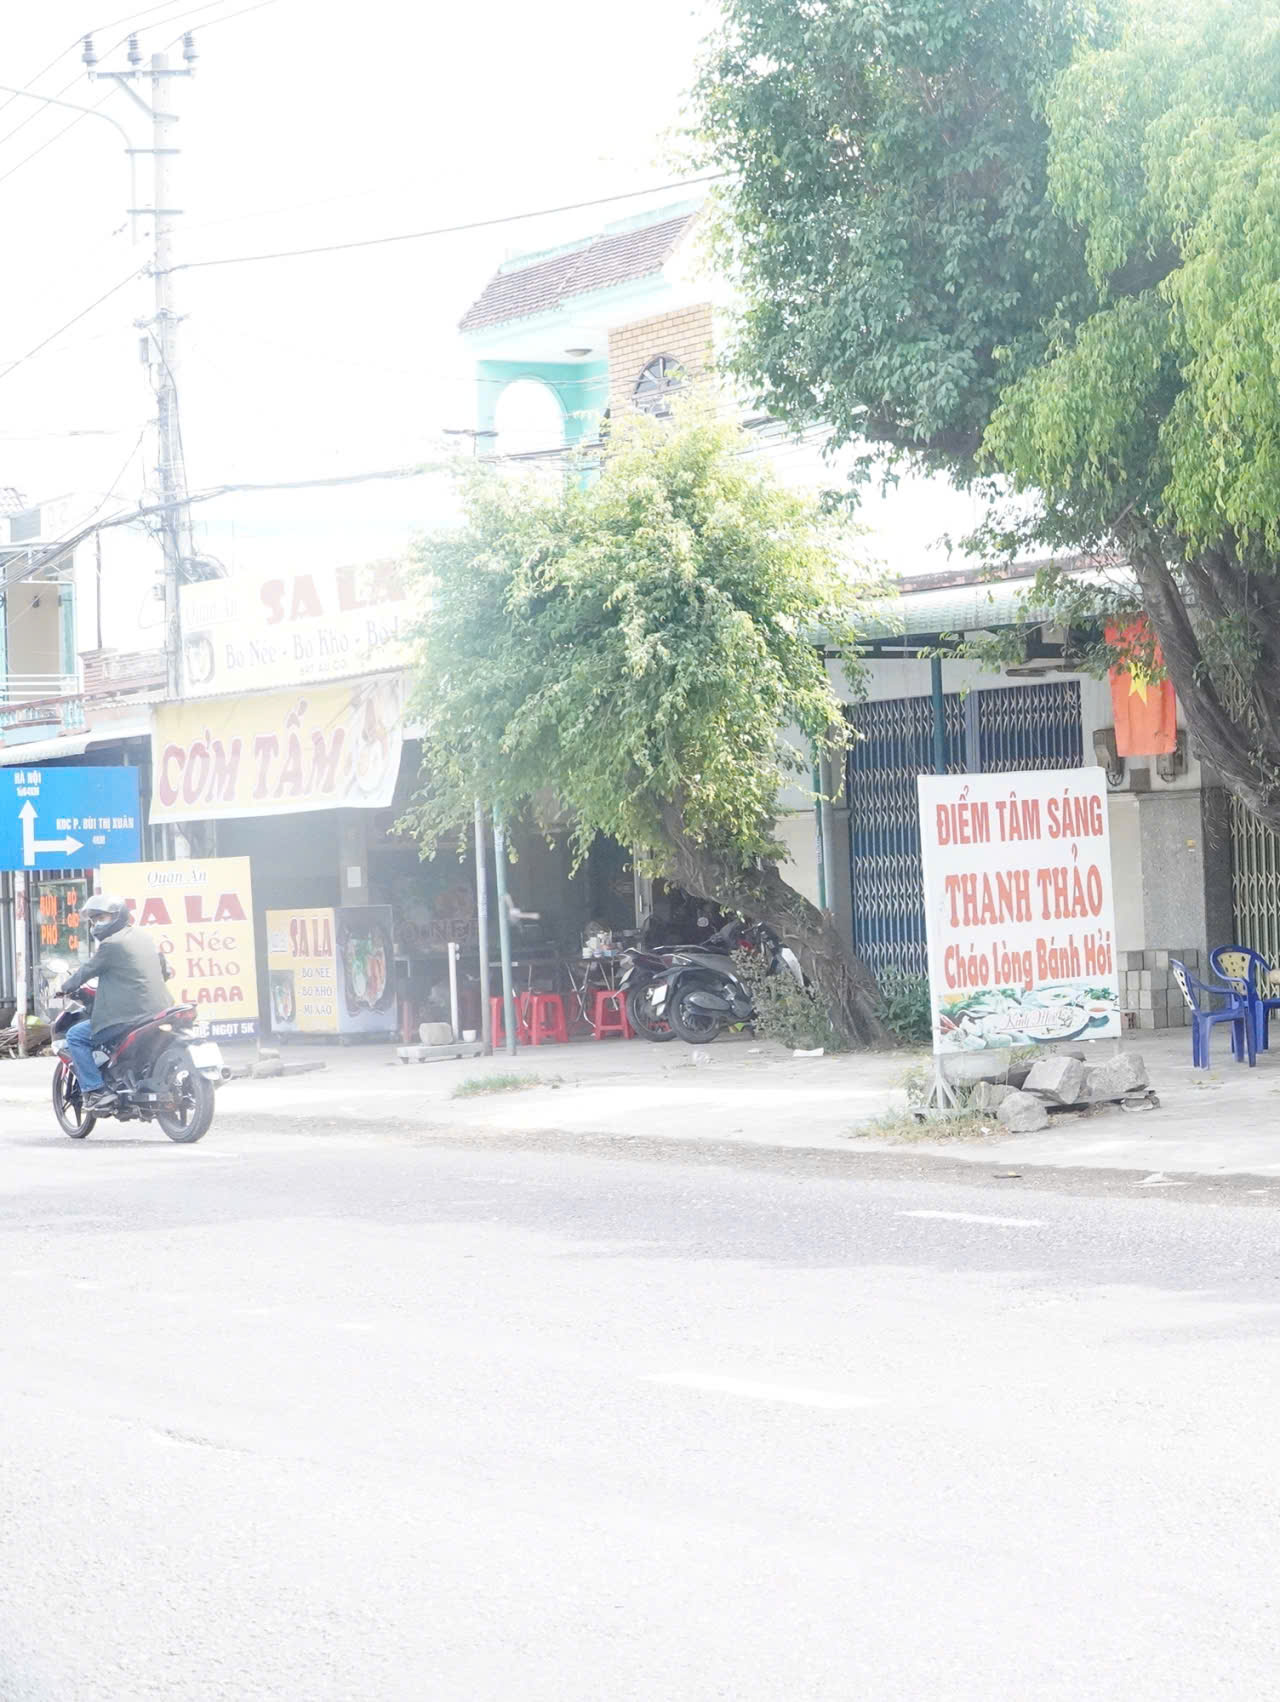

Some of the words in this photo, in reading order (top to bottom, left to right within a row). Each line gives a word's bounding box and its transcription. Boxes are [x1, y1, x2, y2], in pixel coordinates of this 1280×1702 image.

[260, 574, 322, 624] SA
[160, 727, 241, 806] CƠM
[253, 698, 345, 800] TẤM
[28, 769, 42, 786] NỘI
[99, 817, 111, 833] THỊ
[112, 815, 135, 830] XUÂN
[936, 785, 990, 846] ĐIỂM
[995, 791, 1041, 842] TÂM
[1047, 788, 1103, 839] SÁNG
[945, 869, 1032, 928] THANH
[1037, 843, 1103, 920] THẢO
[184, 893, 247, 924] LA
[185, 931, 237, 952] Née
[289, 917, 309, 957] SA
[311, 917, 333, 957] LA
[186, 958, 240, 978] Kho
[944, 942, 990, 989] Cháo
[993, 940, 1034, 991] Lòng
[1035, 934, 1081, 983] Bánh
[1083, 928, 1112, 976] Hỏi
[211, 1023, 239, 1037] NGỌT
[240, 1022, 255, 1034] 5K
